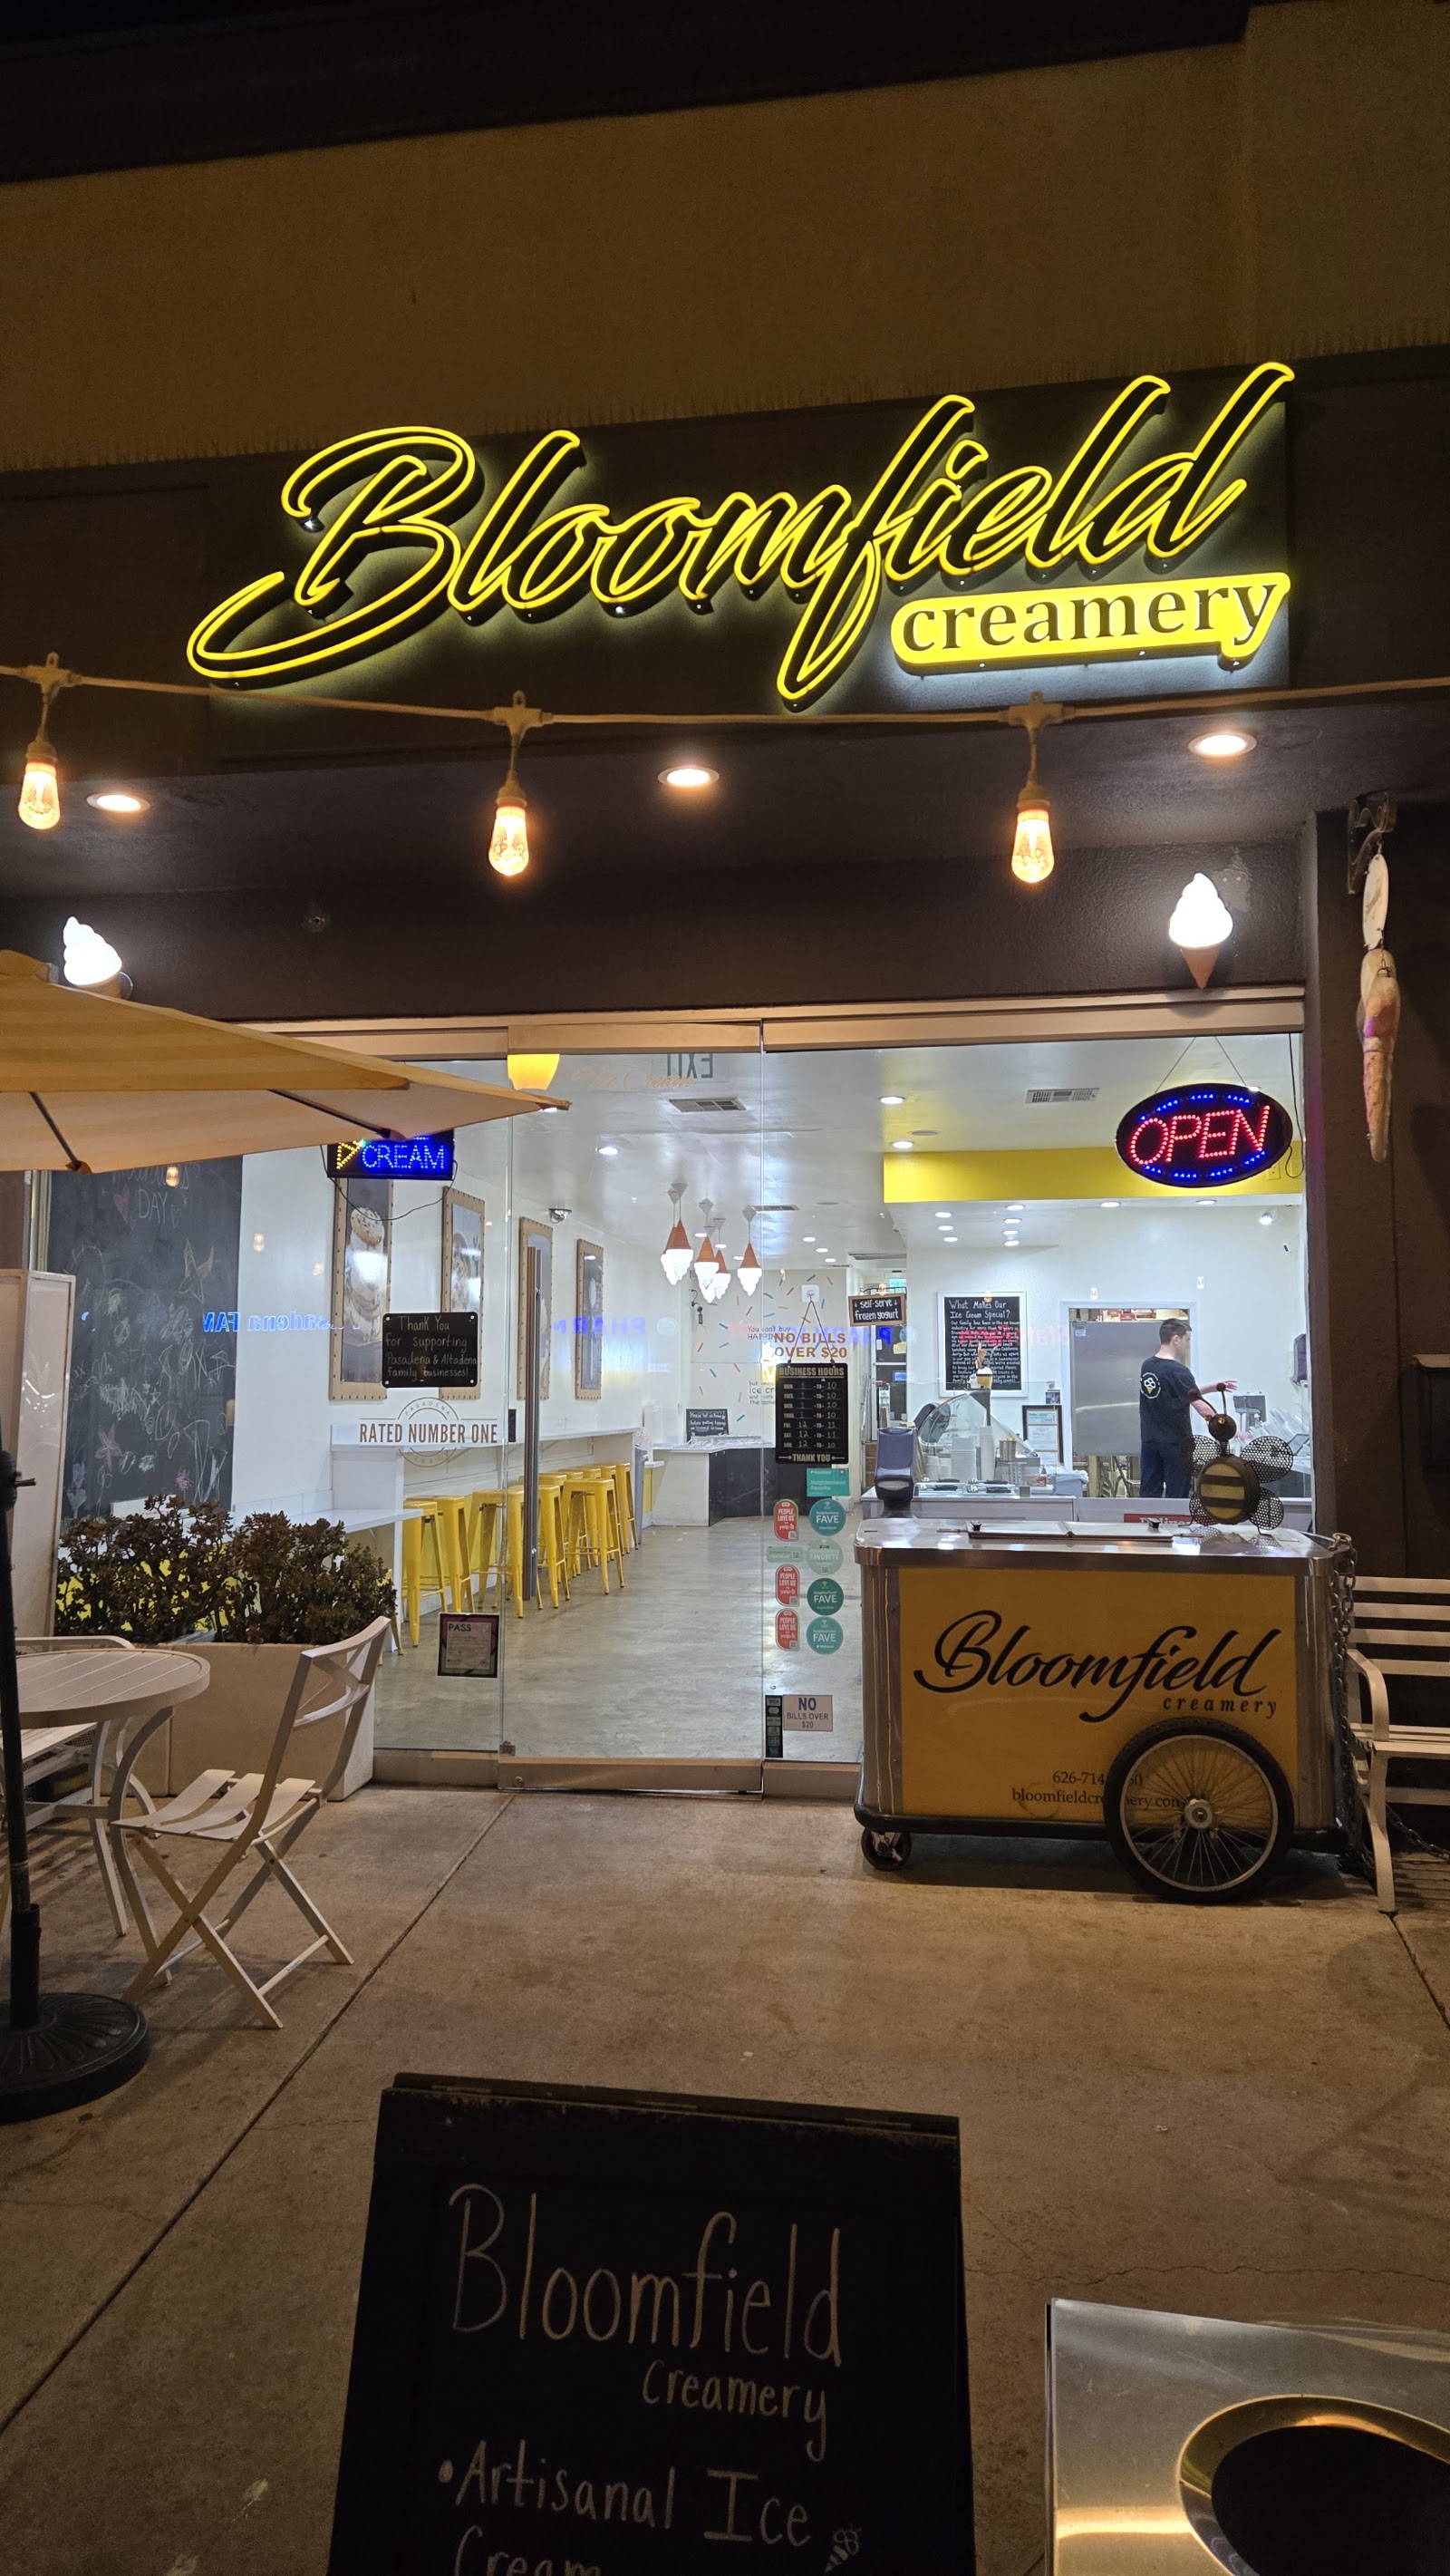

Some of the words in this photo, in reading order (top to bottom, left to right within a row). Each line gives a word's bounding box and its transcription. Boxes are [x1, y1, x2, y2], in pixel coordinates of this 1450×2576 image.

[187, 362, 1295, 710] Bloomfield
[904, 580, 1279, 652] creamery
[1129, 1105, 1271, 1166] OPEN
[362, 1144, 445, 1169] CREAM
[138, 1188, 169, 1224] DAY
[859, 1299, 893, 1309] self-serve
[949, 1299, 969, 1310] What
[994, 1300, 1007, 1309] Our
[855, 1310, 876, 1321] frozen
[876, 1308, 899, 1320] yogurt
[949, 1311, 962, 1319] Ice
[435, 1314, 450, 1331] You
[385, 1332, 401, 1347] for
[412, 1334, 468, 1353] supporting
[774, 1333, 796, 1343] NO
[801, 1333, 846, 1343] BILLS
[385, 1351, 430, 1365] Pasadena
[433, 1354, 440, 1365] &
[440, 1354, 478, 1365] Altadena
[774, 1347, 817, 1358] OVER
[820, 1346, 847, 1359] $20
[388, 1366, 418, 1382] family
[423, 1367, 469, 1377] businesses!
[779, 1367, 817, 1376] BUSINESS
[817, 1367, 845, 1376] HOURS
[826, 1381, 837, 1390] 10
[359, 1423, 403, 1443] RATED
[408, 1423, 466, 1444] NUMBER
[470, 1424, 498, 1444] ONE
[792, 1453, 816, 1462] THANK
[816, 1454, 831, 1462] YOU
[816, 1515, 839, 1524] FAVE
[813, 1595, 837, 1603] FAVE
[448, 1622, 472, 1632] PASS
[813, 1633, 836, 1642] FAVE
[913, 1609, 1282, 1723] Bloomfield
[798, 1697, 817, 1711] NO
[1163, 1694, 1277, 1719] creamery
[787, 1712, 807, 1720] BILLS
[449, 2183, 842, 2368] Bloomfield
[642, 2358, 826, 2462] Creamery
[455, 2439, 675, 2529] Artisanal
[703, 2468, 812, 2547] Ice
